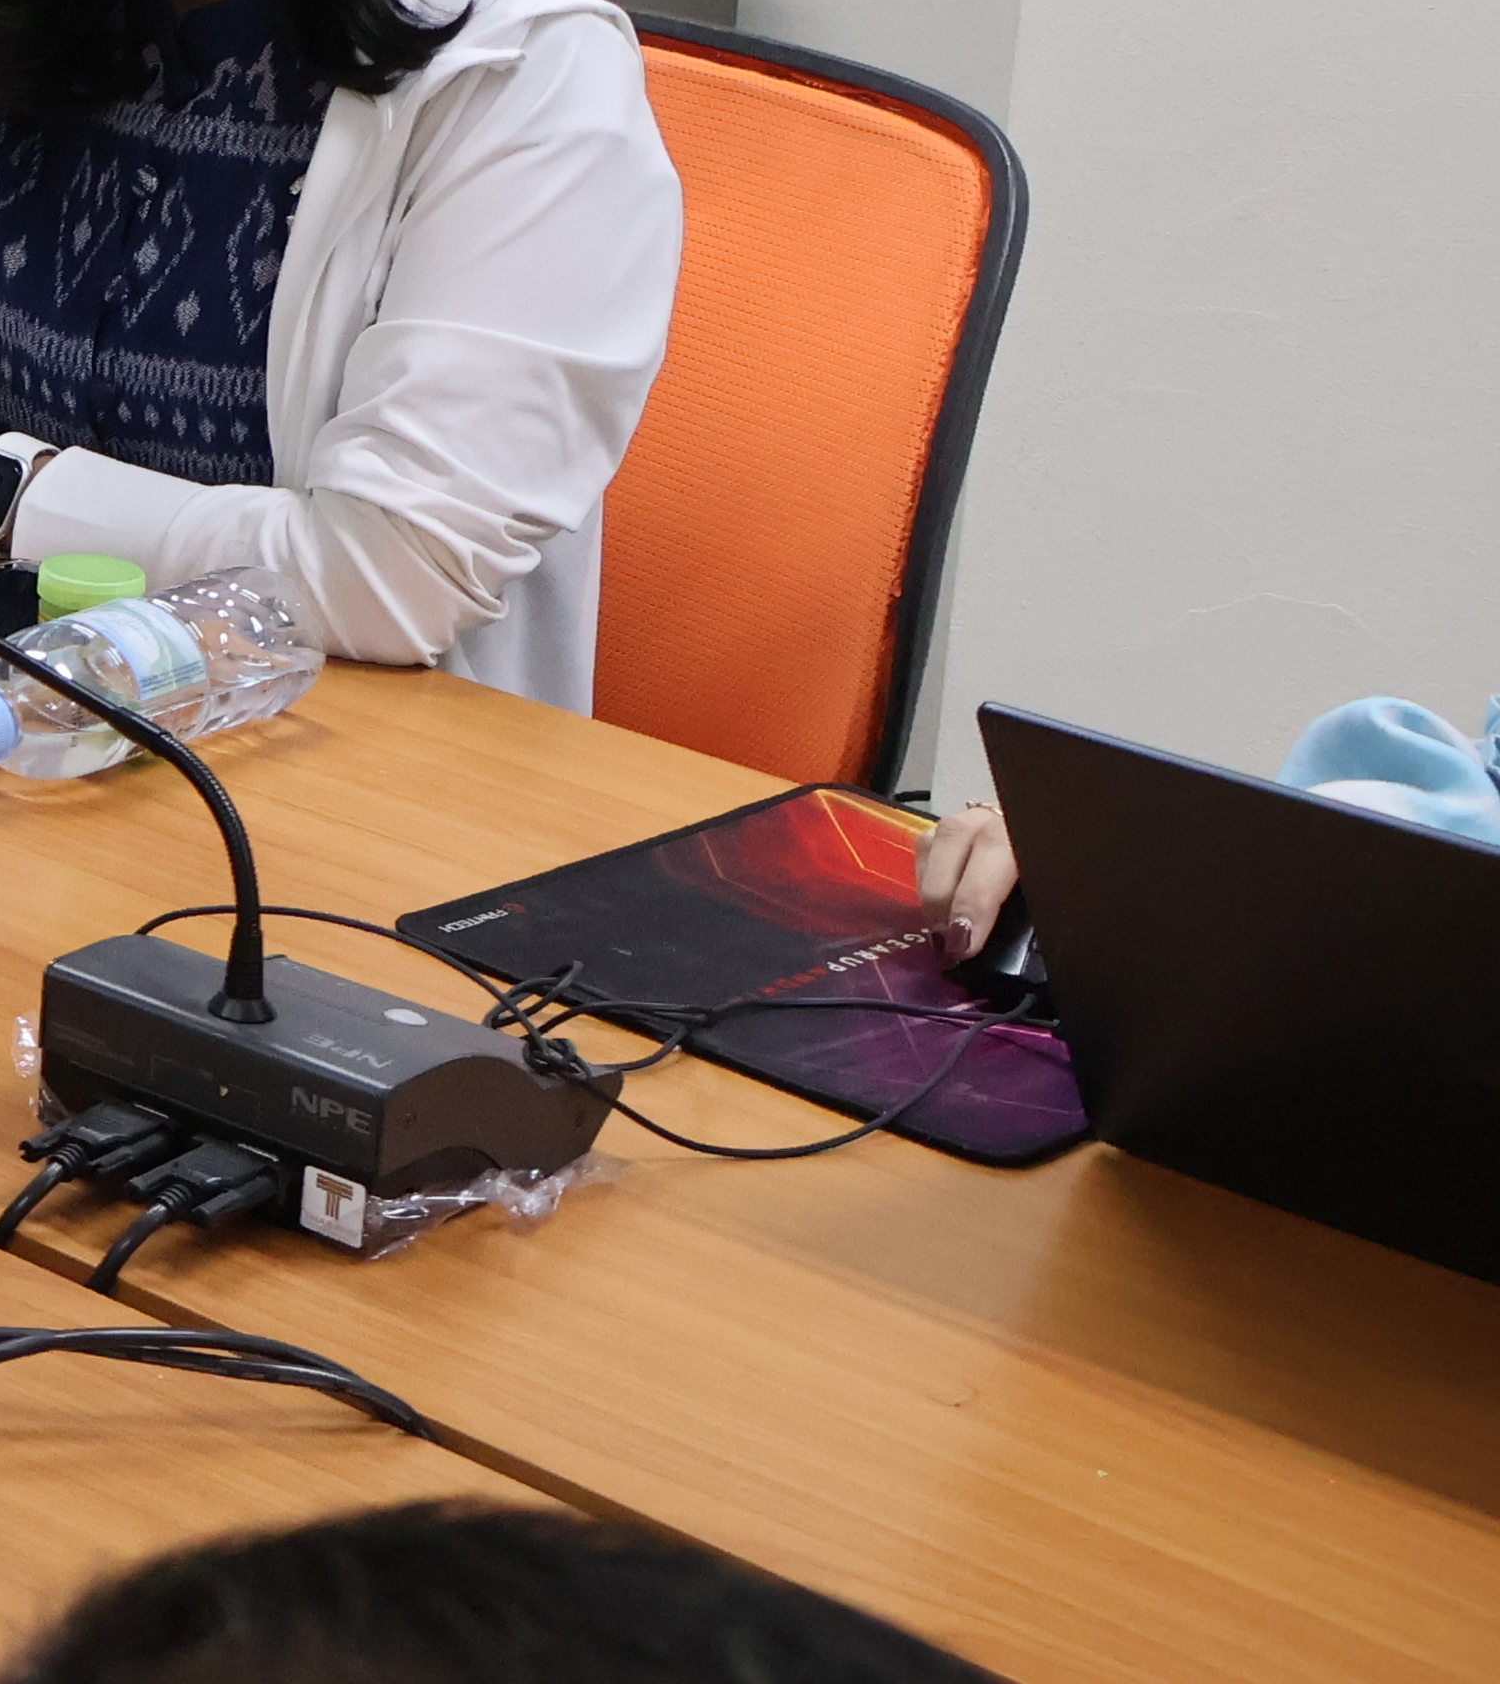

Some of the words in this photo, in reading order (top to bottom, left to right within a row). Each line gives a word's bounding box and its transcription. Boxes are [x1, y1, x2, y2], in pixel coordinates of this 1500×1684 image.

[438, 909, 509, 933] FANTECH
[302, 1033, 391, 1070] NPE
[290, 1086, 372, 1136] NPE
